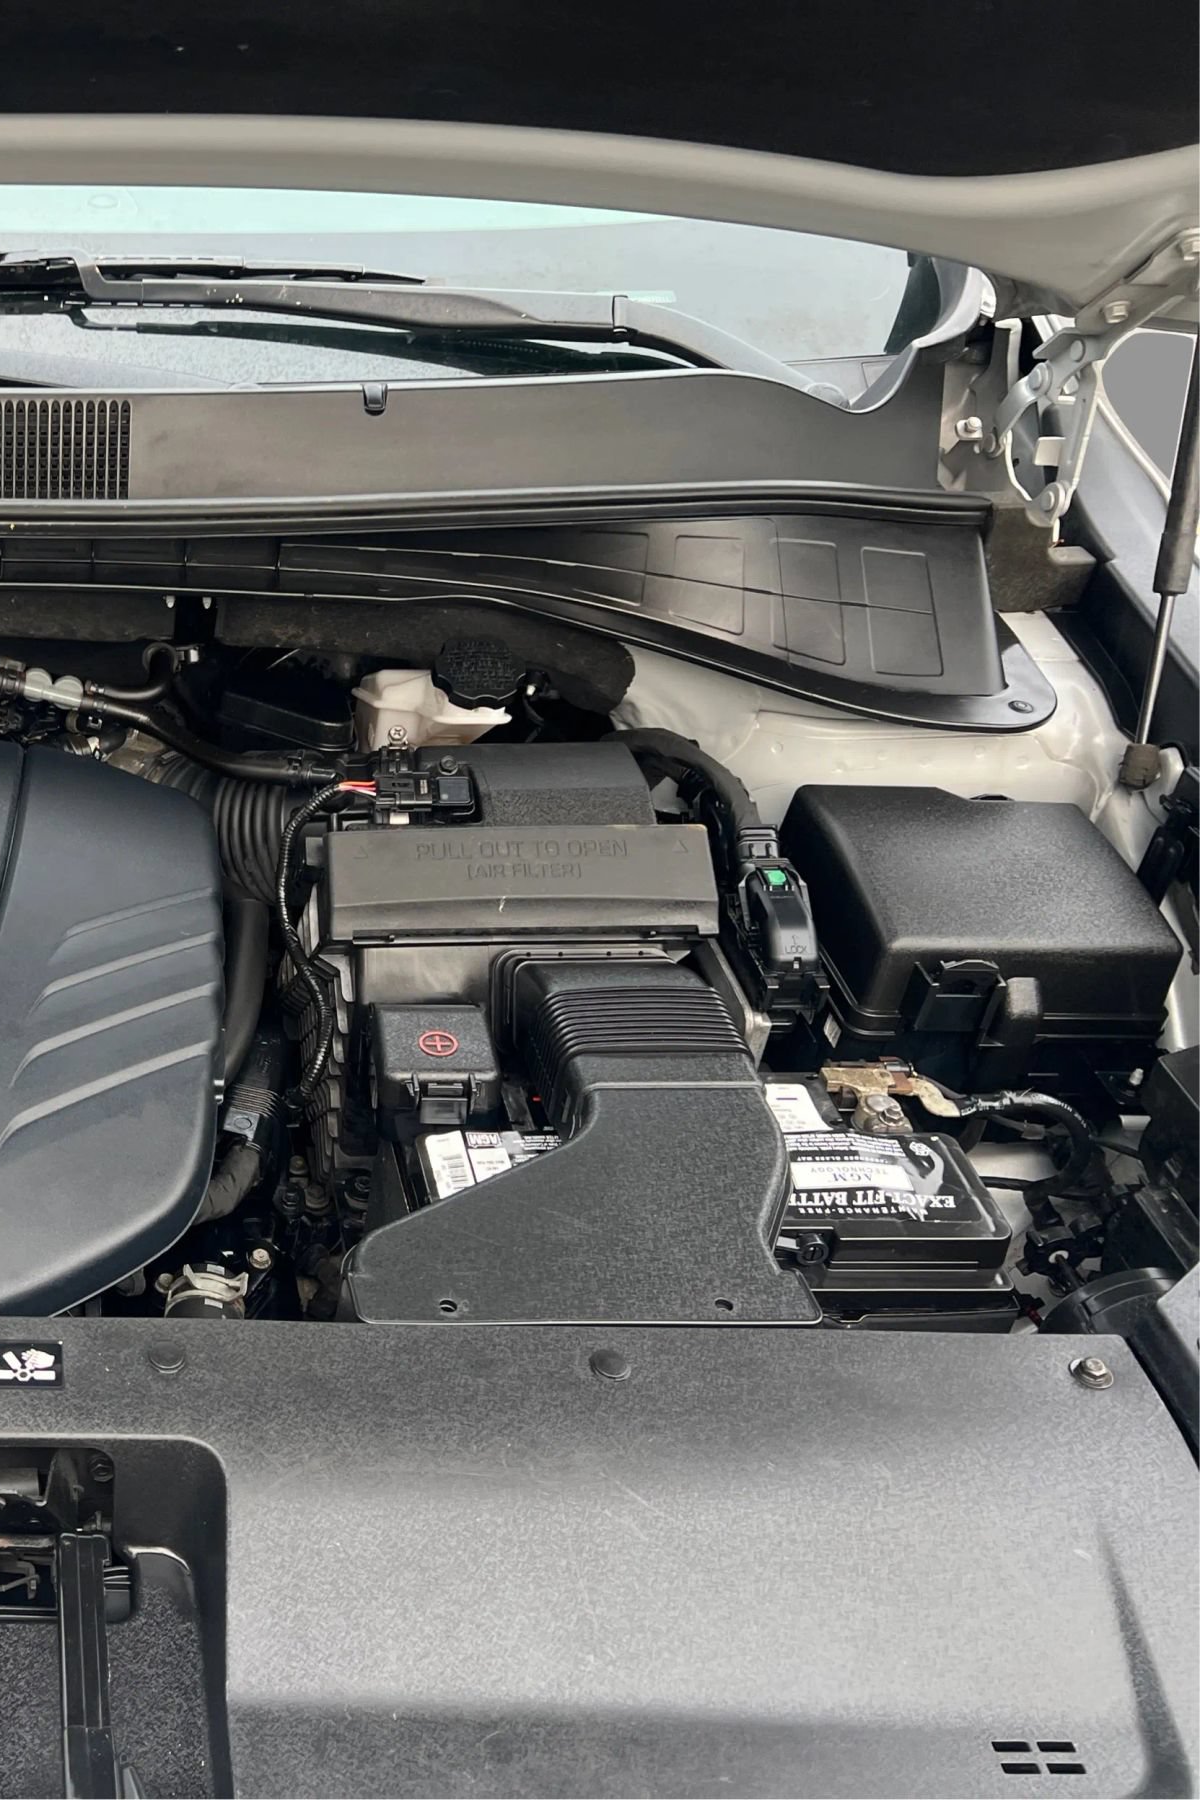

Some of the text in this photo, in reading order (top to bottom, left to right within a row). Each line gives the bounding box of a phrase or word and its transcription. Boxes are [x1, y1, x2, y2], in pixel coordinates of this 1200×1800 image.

[416, 839, 629, 861] PULL OUT TO OPEN
[784, 945, 807, 955] LOCK
[468, 1133, 498, 1146] AGM
[853, 1190, 957, 1209] EXACT-FIT
